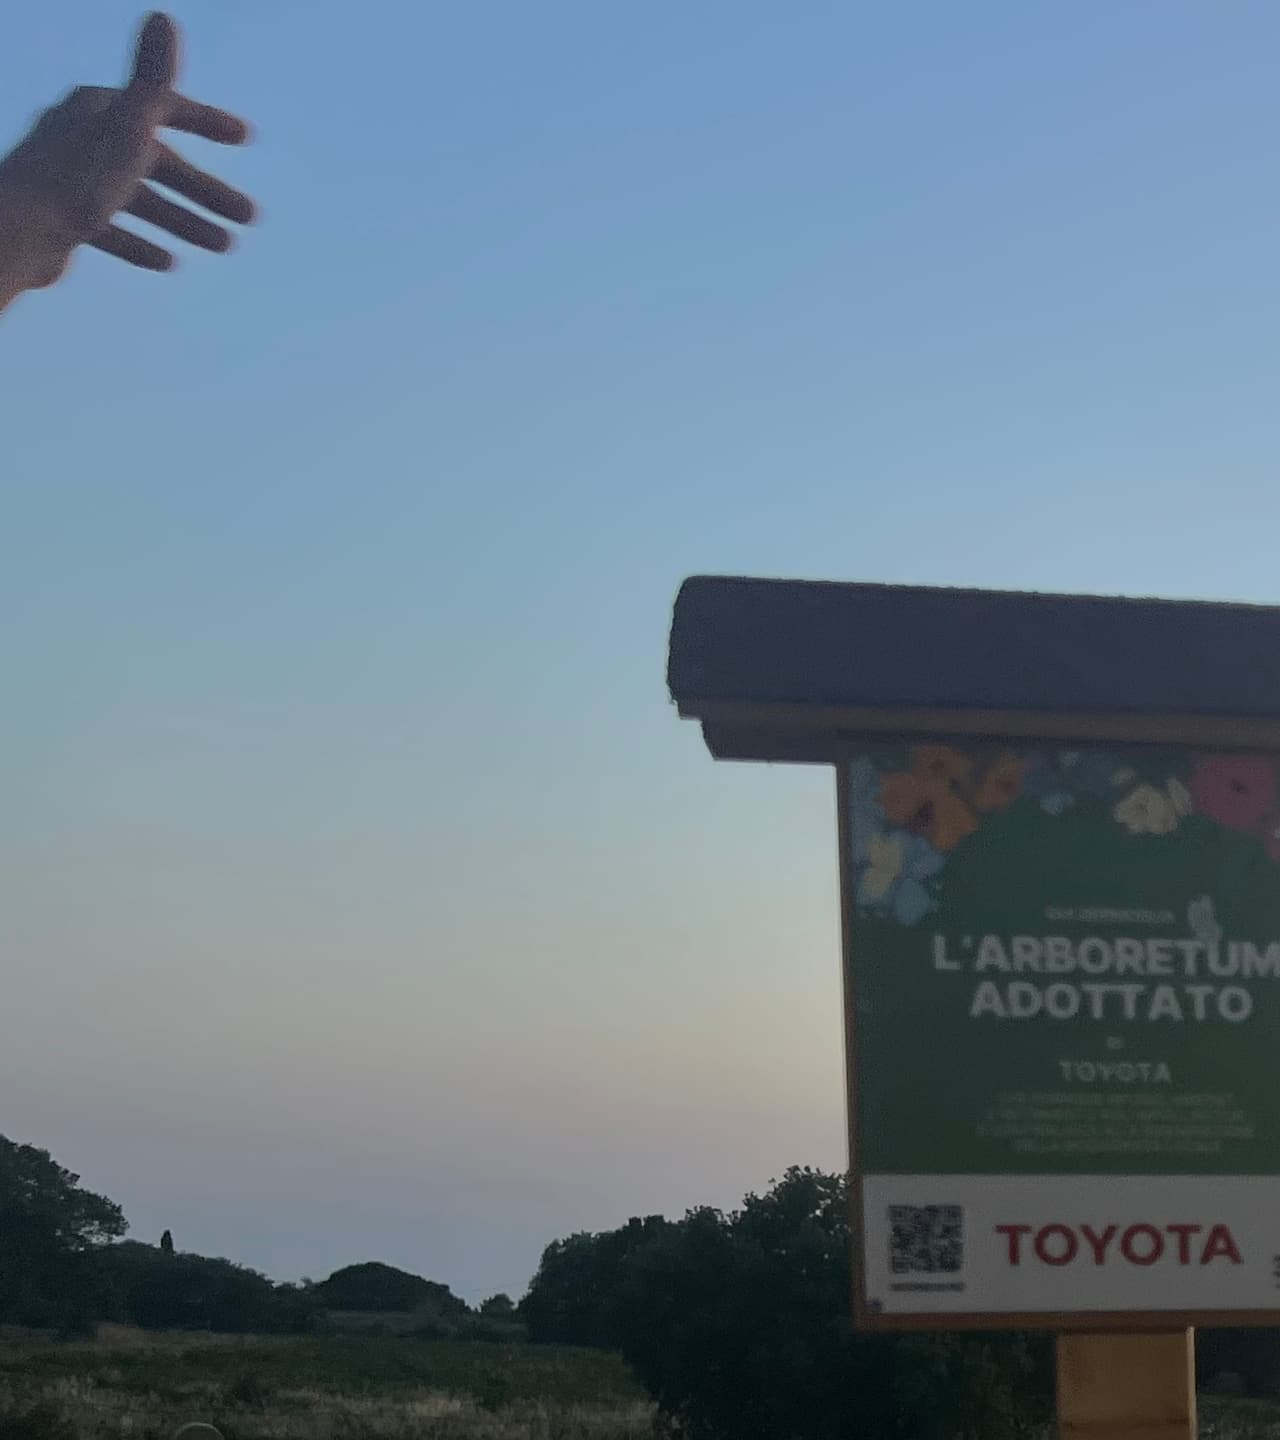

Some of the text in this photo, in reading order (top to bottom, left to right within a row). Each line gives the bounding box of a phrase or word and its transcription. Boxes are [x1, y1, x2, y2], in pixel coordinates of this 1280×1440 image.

[969, 982, 1254, 1021] ADOTTATO
[1058, 1060, 1173, 1083] TOYOTA
[995, 1223, 1244, 1266] TOYOTA
